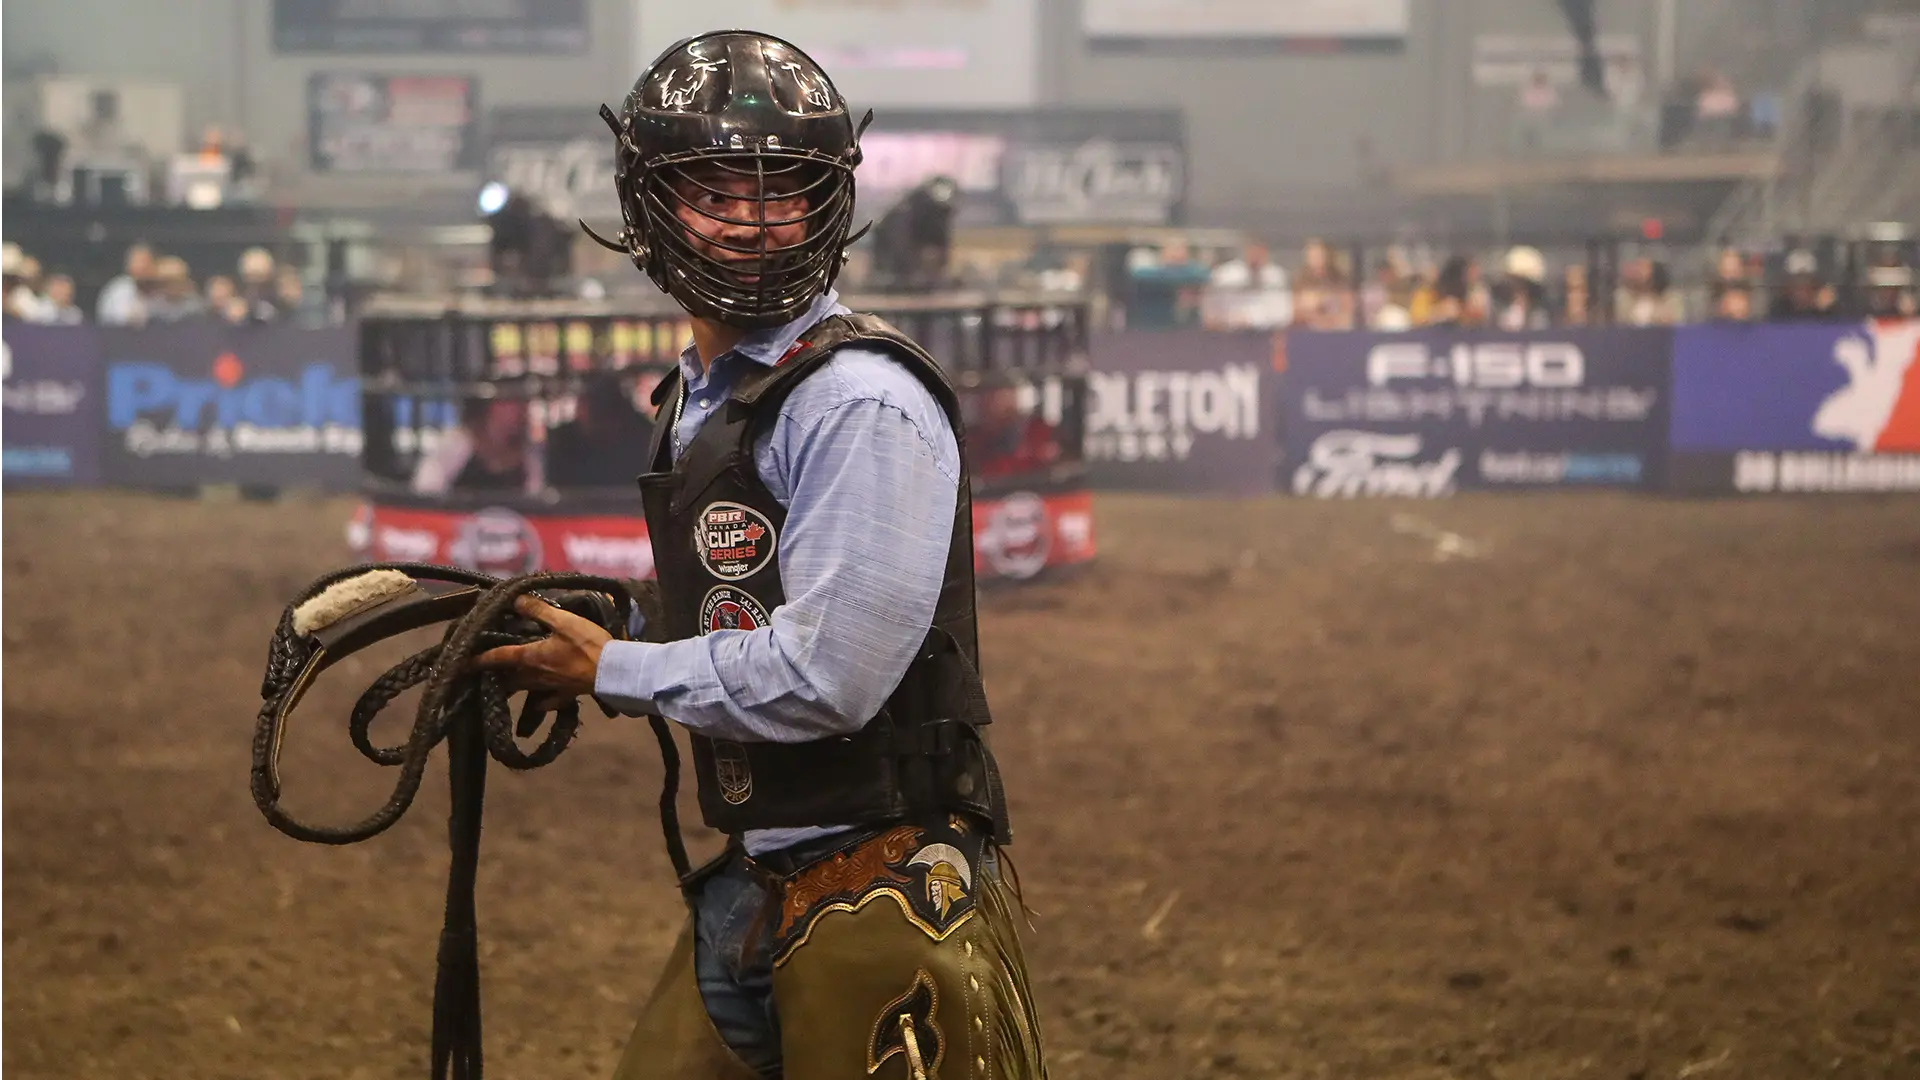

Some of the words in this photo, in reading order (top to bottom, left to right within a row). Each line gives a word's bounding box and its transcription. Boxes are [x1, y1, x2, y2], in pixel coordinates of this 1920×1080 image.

[1367, 341, 1584, 388] F-150
[1293, 428, 1461, 498] Ford
[709, 511, 741, 522] PBR
[709, 523, 747, 531] CANADA
[708, 530, 746, 549] CUP
[710, 546, 756, 560] SERIES
[718, 563, 749, 576] Wrangler
[725, 791, 748, 802] PRO
